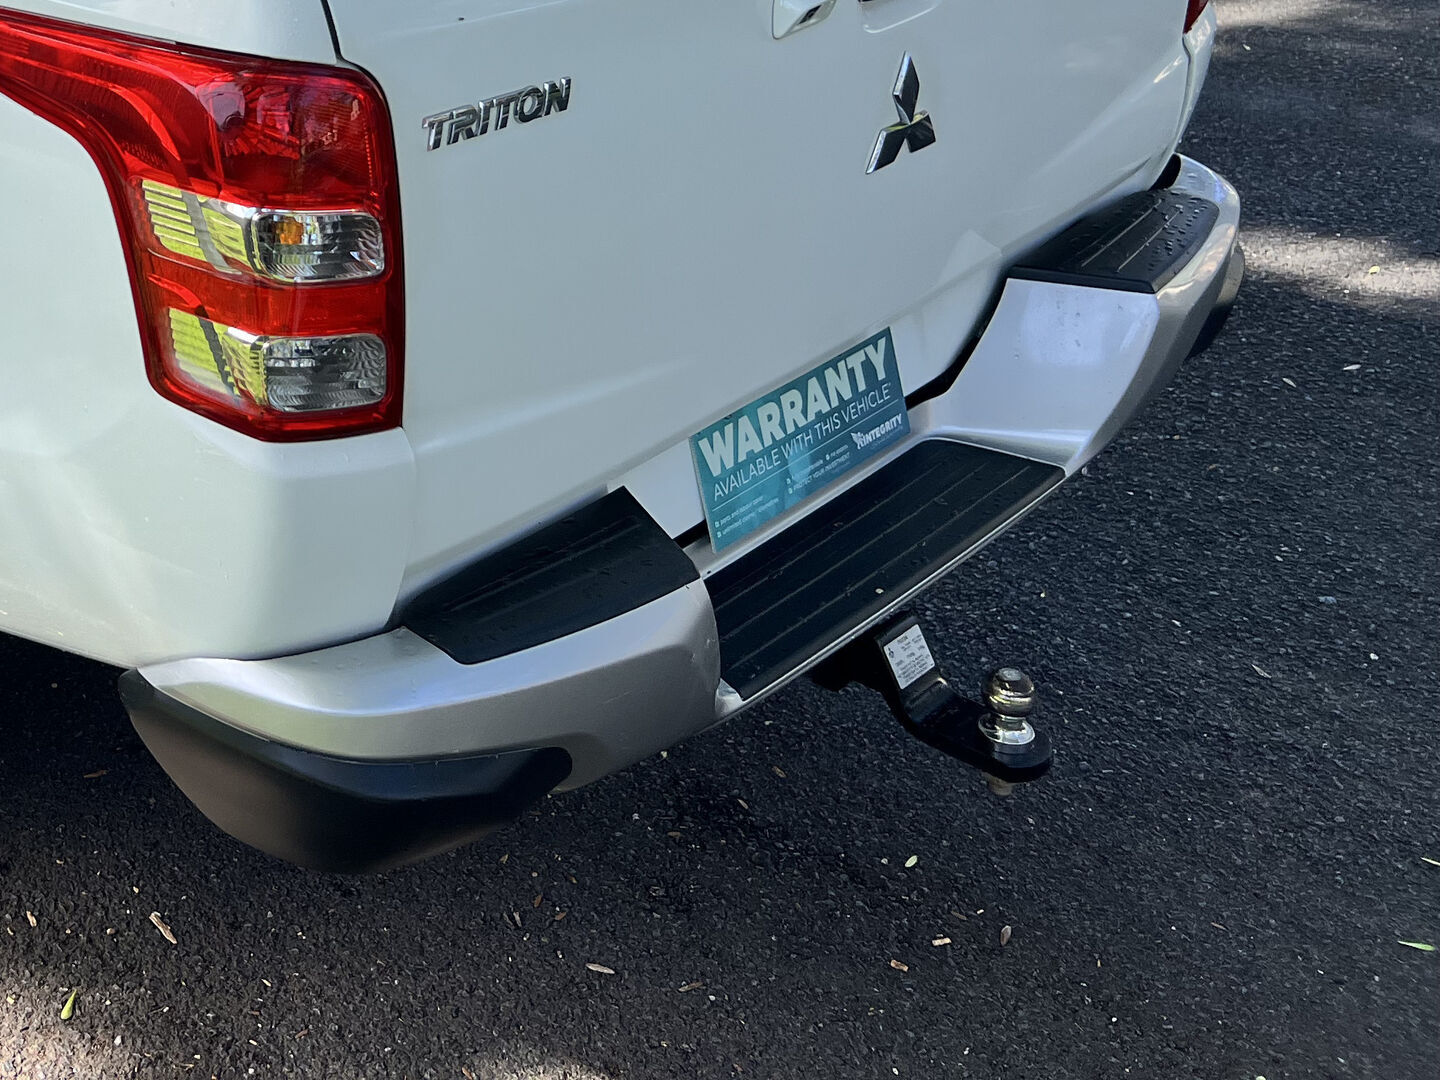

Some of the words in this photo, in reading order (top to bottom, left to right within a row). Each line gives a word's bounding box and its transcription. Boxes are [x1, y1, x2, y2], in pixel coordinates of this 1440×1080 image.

[421, 76, 572, 152] TRITON
[698, 337, 887, 478] WARRANTY
[861, 413, 902, 448] INTEGRITY
[714, 449, 782, 501] AVAILABLE
[781, 432, 814, 460] WITH
[814, 415, 841, 441] THIS
